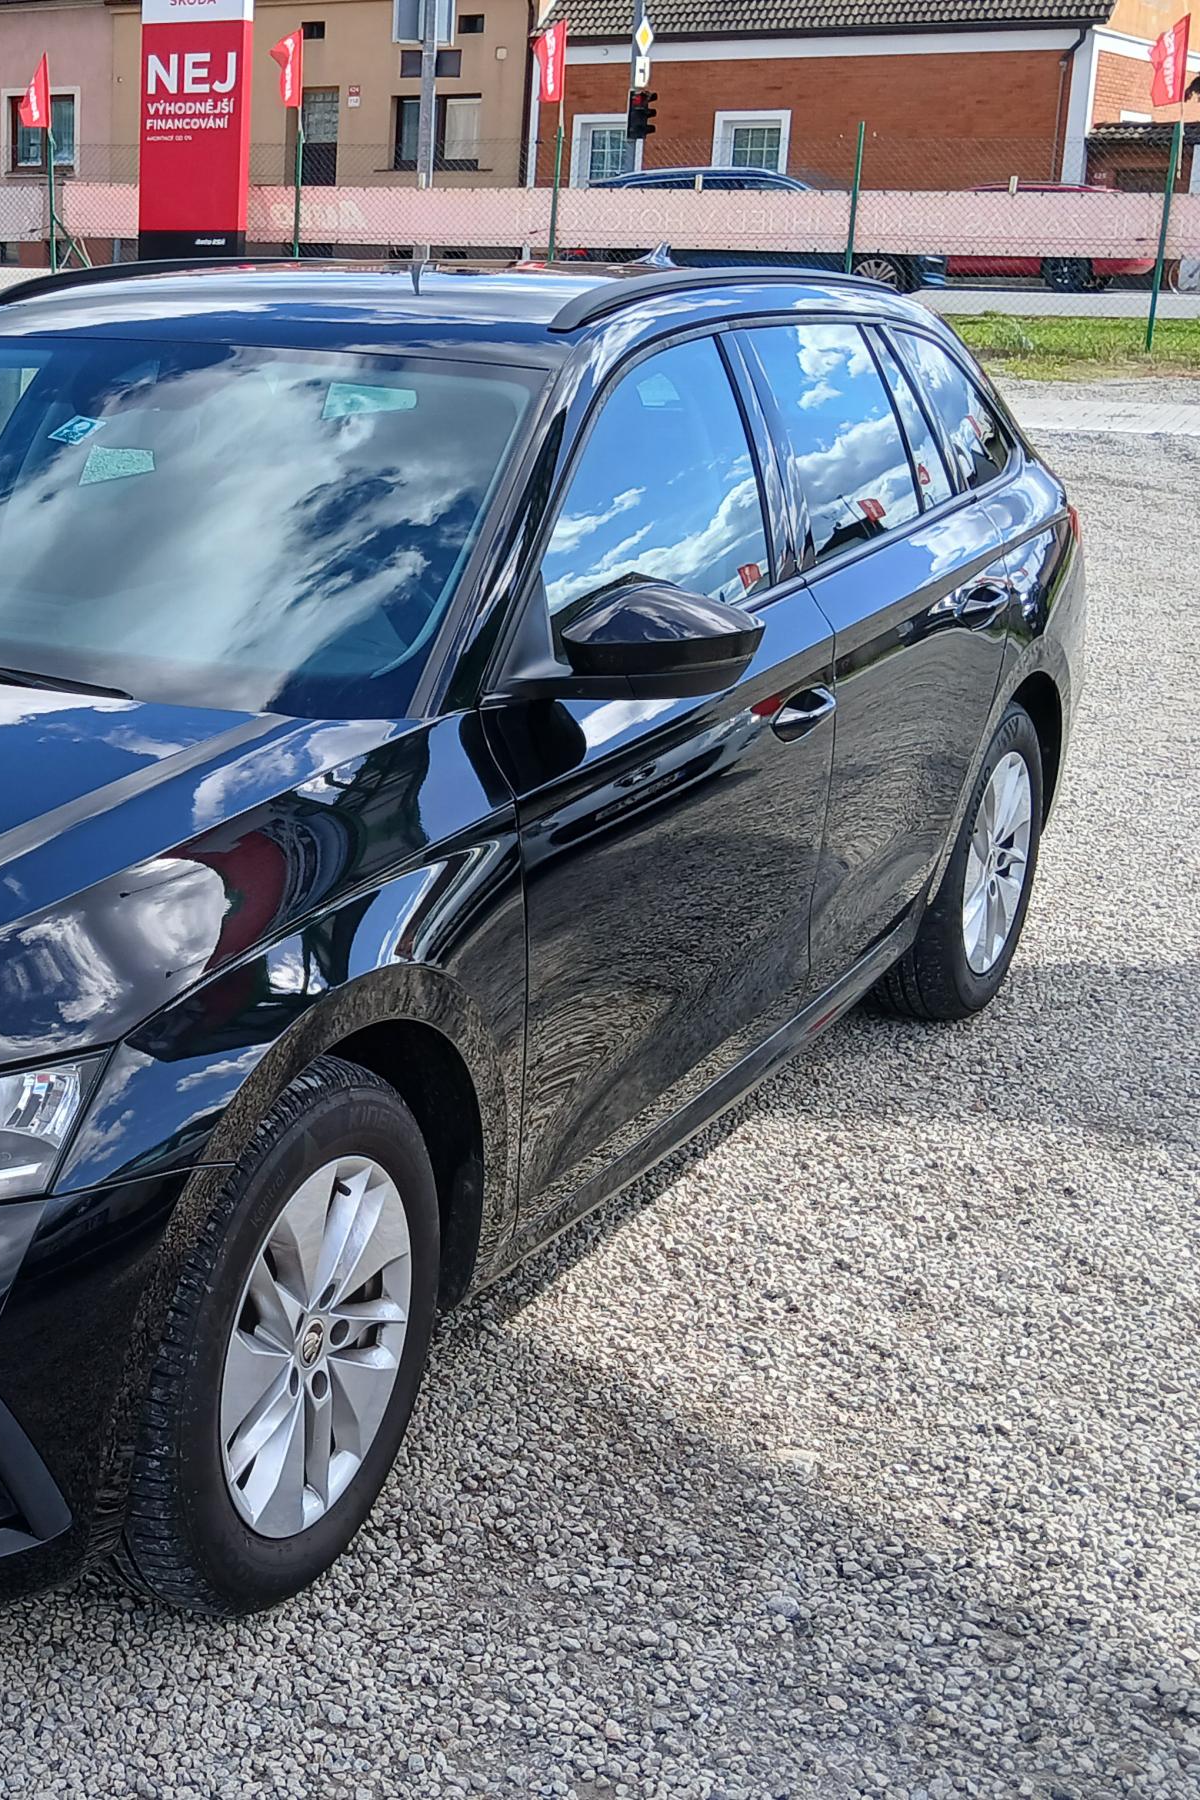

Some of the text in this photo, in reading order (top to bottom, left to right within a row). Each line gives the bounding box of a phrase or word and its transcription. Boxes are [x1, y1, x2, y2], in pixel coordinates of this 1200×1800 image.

[147, 51, 237, 95] NEJ
[147, 97, 235, 115] VÝHODNĚJŠÍ
[146, 116, 229, 131] FINANCOVÁNÍ
